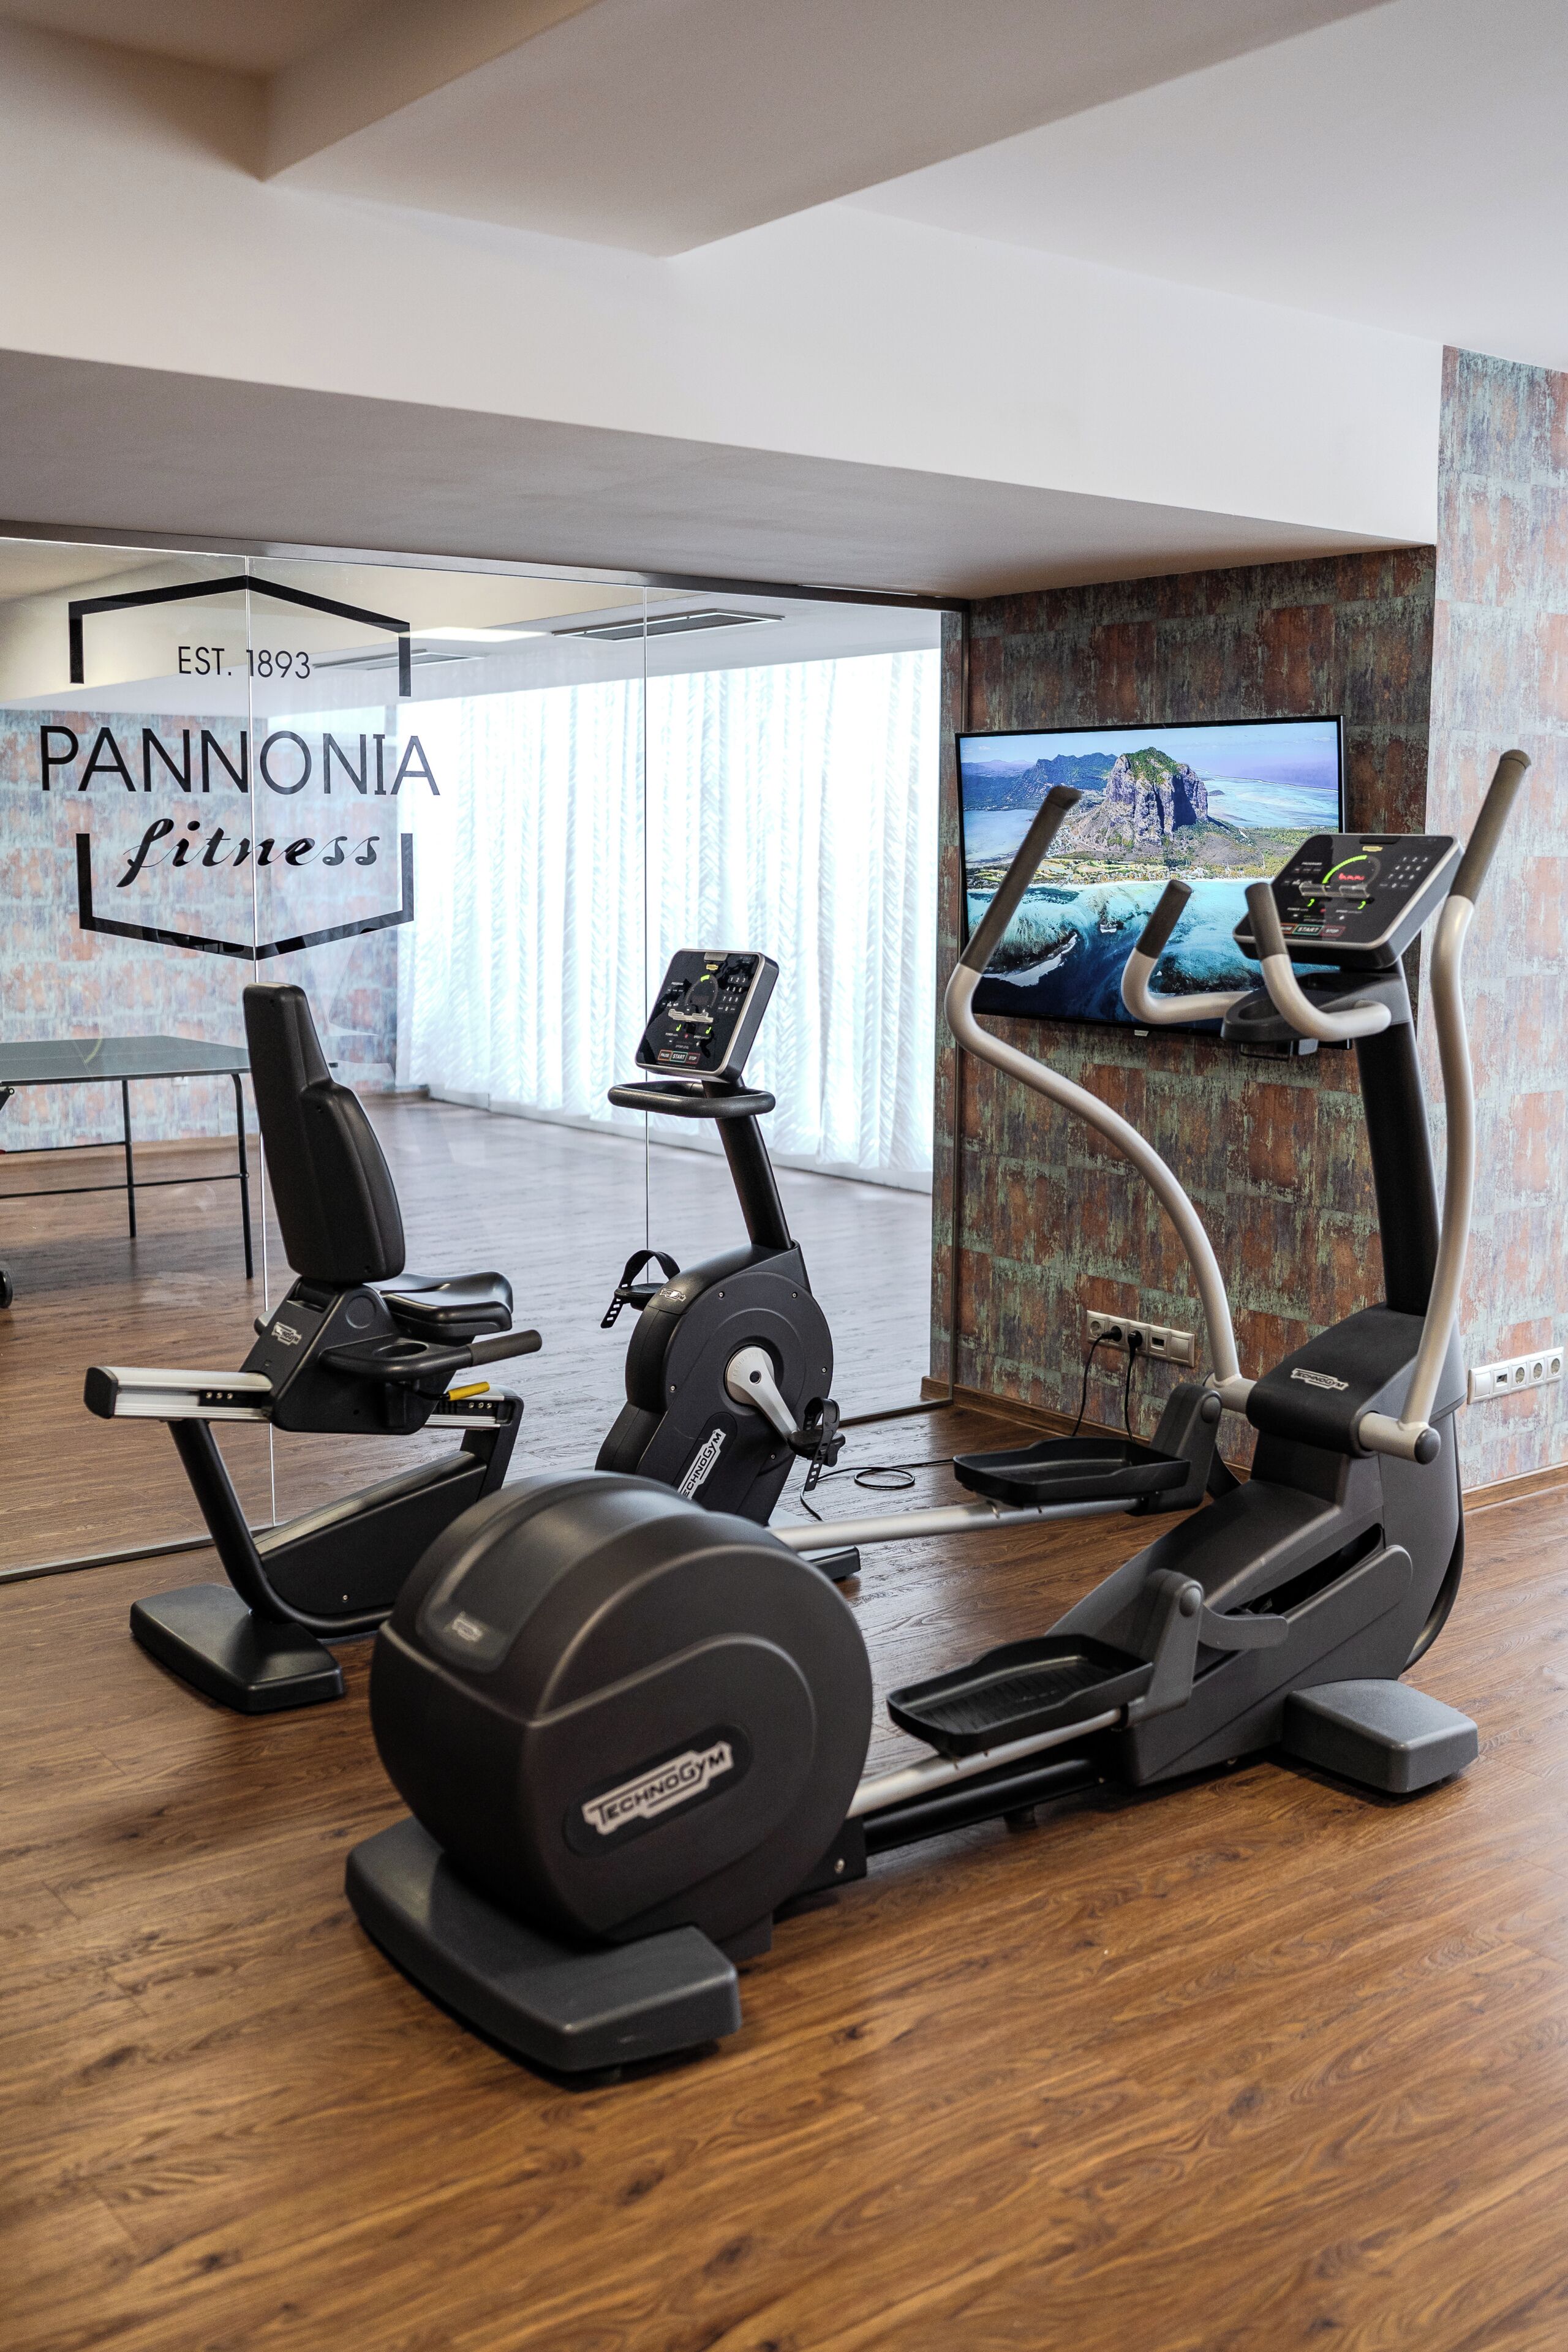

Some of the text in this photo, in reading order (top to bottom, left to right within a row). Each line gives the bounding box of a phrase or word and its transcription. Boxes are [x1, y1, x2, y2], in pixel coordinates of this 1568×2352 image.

[178, 646, 310, 679] EST. 1893
[40, 725, 440, 796] PANNONIA
[116, 818, 380, 888] fitness
[679, 1431, 723, 1498] ECHNOGYM
[586, 1746, 727, 1826] TECHNOGYM
